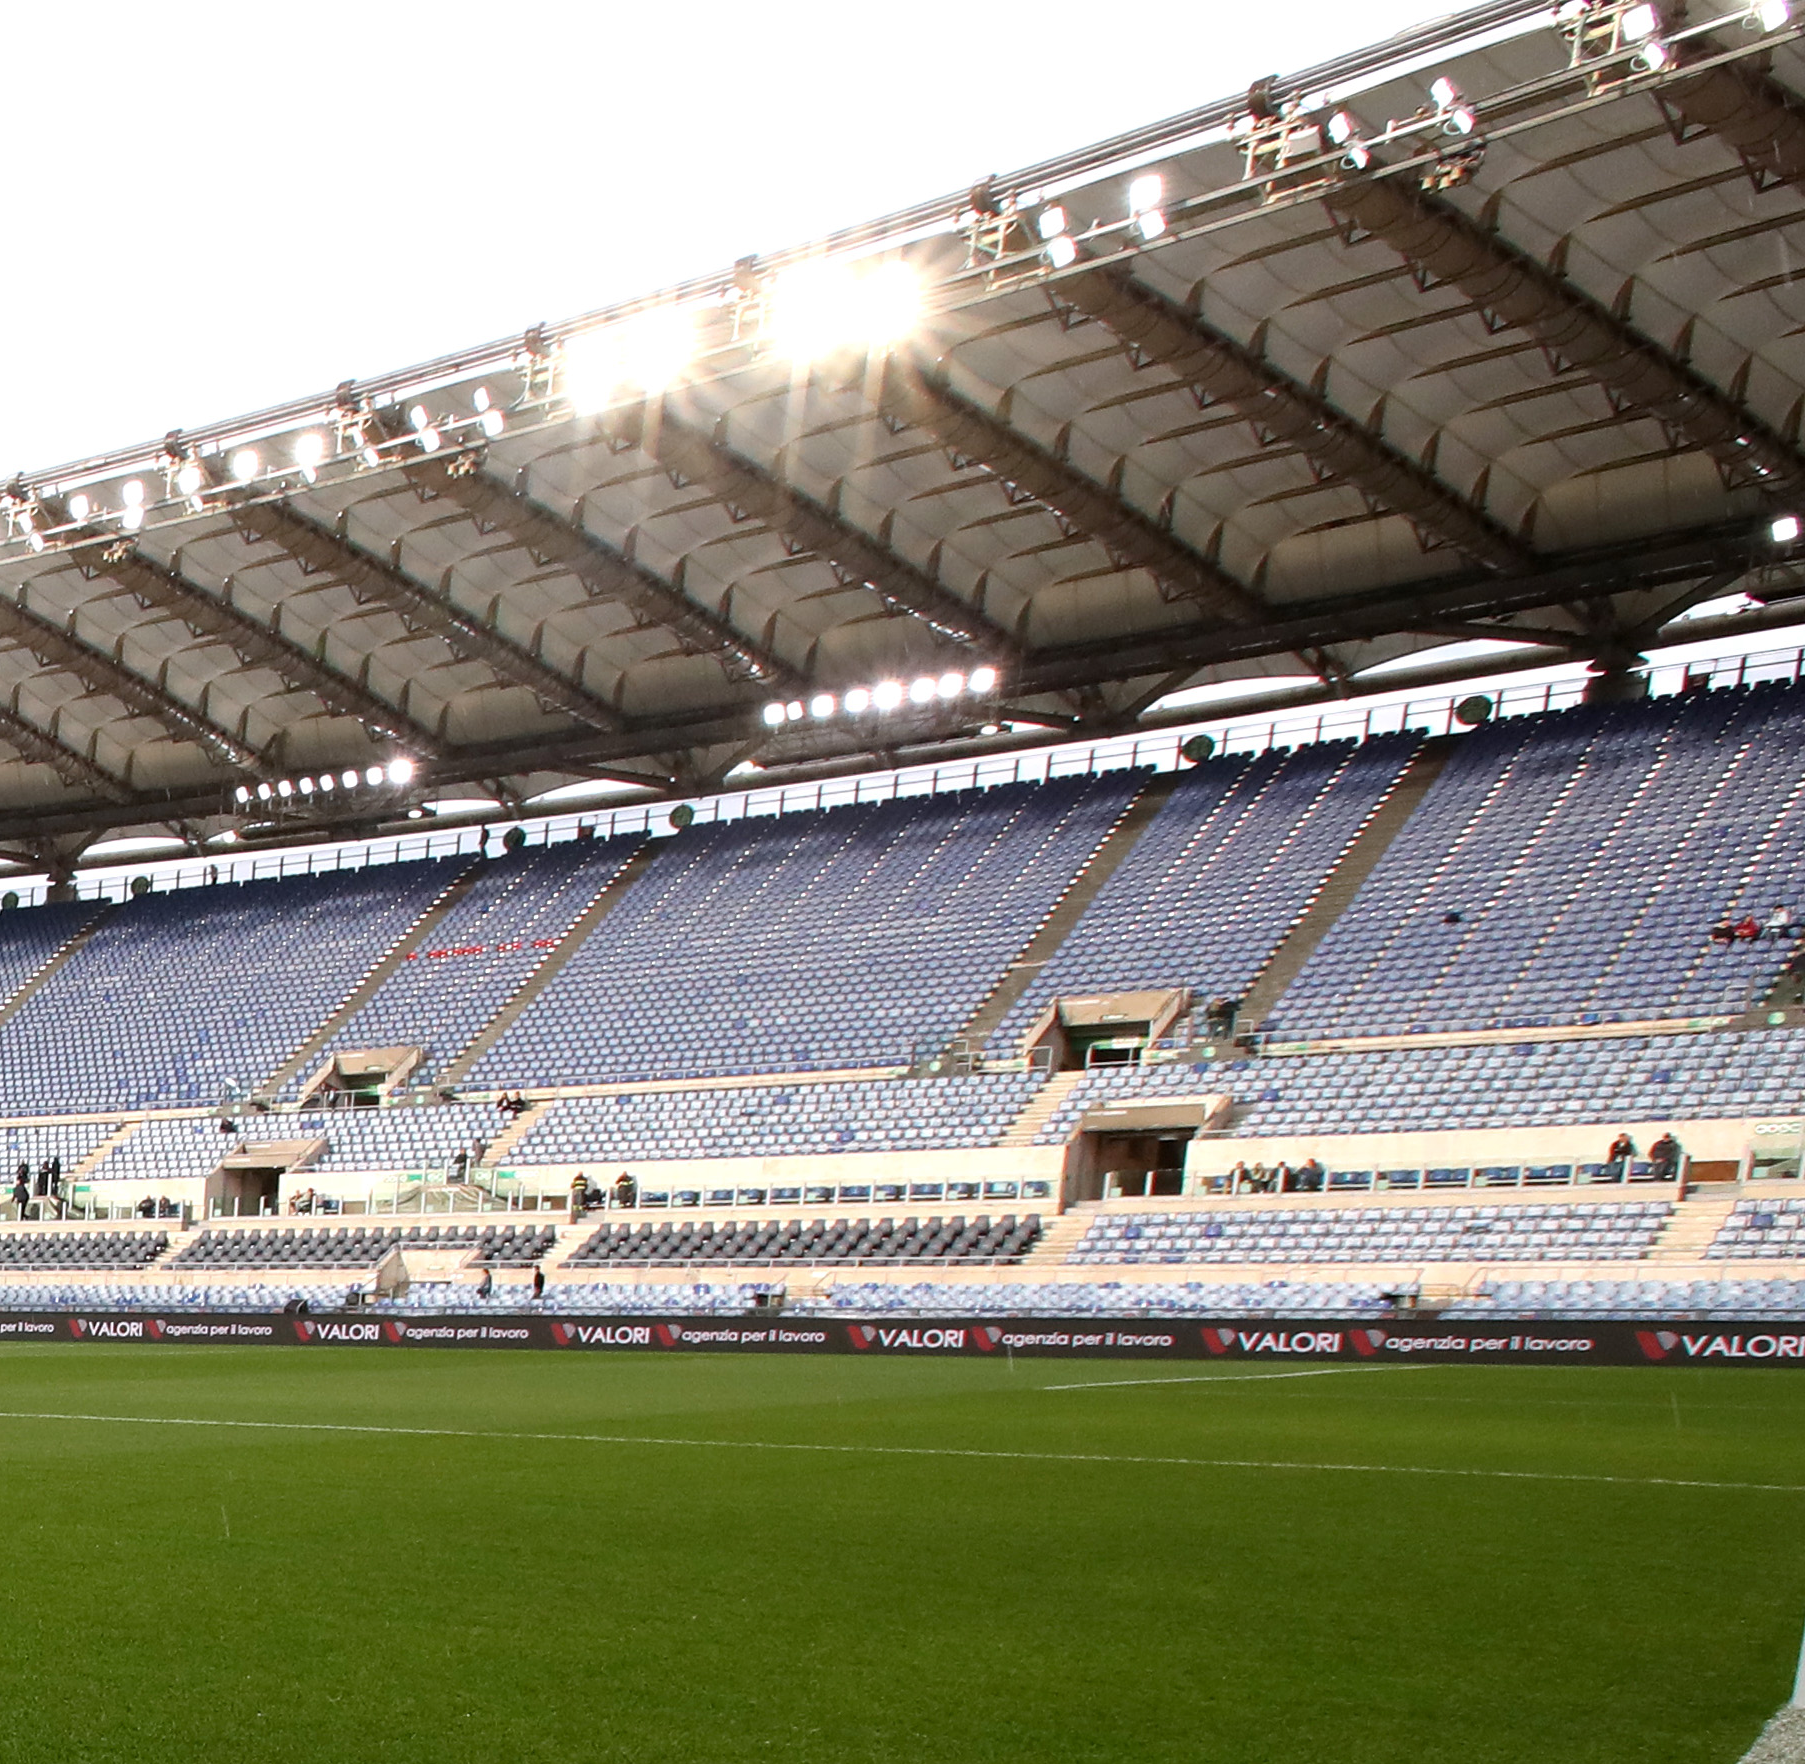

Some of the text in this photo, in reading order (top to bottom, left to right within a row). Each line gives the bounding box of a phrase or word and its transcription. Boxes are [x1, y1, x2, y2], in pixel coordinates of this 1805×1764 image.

[90, 1322, 142, 1336] VALORI
[167, 1325, 208, 1335] agenzia
[210, 1326, 228, 1336] per
[237, 1325, 271, 1335] lavoro
[318, 1324, 378, 1339] VALORI
[406, 1328, 454, 1339] agenzia
[457, 1329, 478, 1340] per
[489, 1328, 529, 1338] lavoro
[578, 1327, 650, 1343] VALORI
[682, 1331, 737, 1343] agenzia
[741, 1332, 765, 1344] per
[778, 1331, 824, 1342] lavoro
[879, 1330, 964, 1347] VALORI
[1003, 1332, 1069, 1346] agenzia
[1073, 1335, 1102, 1347] per
[1117, 1334, 1172, 1346] lavoro
[1239, 1333, 1339, 1352] VALORI
[1386, 1336, 1466, 1351] agenzia
[1471, 1339, 1506, 1352] per
[1525, 1337, 1592, 1350] lavoro
[1681, 1336, 1805, 1356] VALORI
